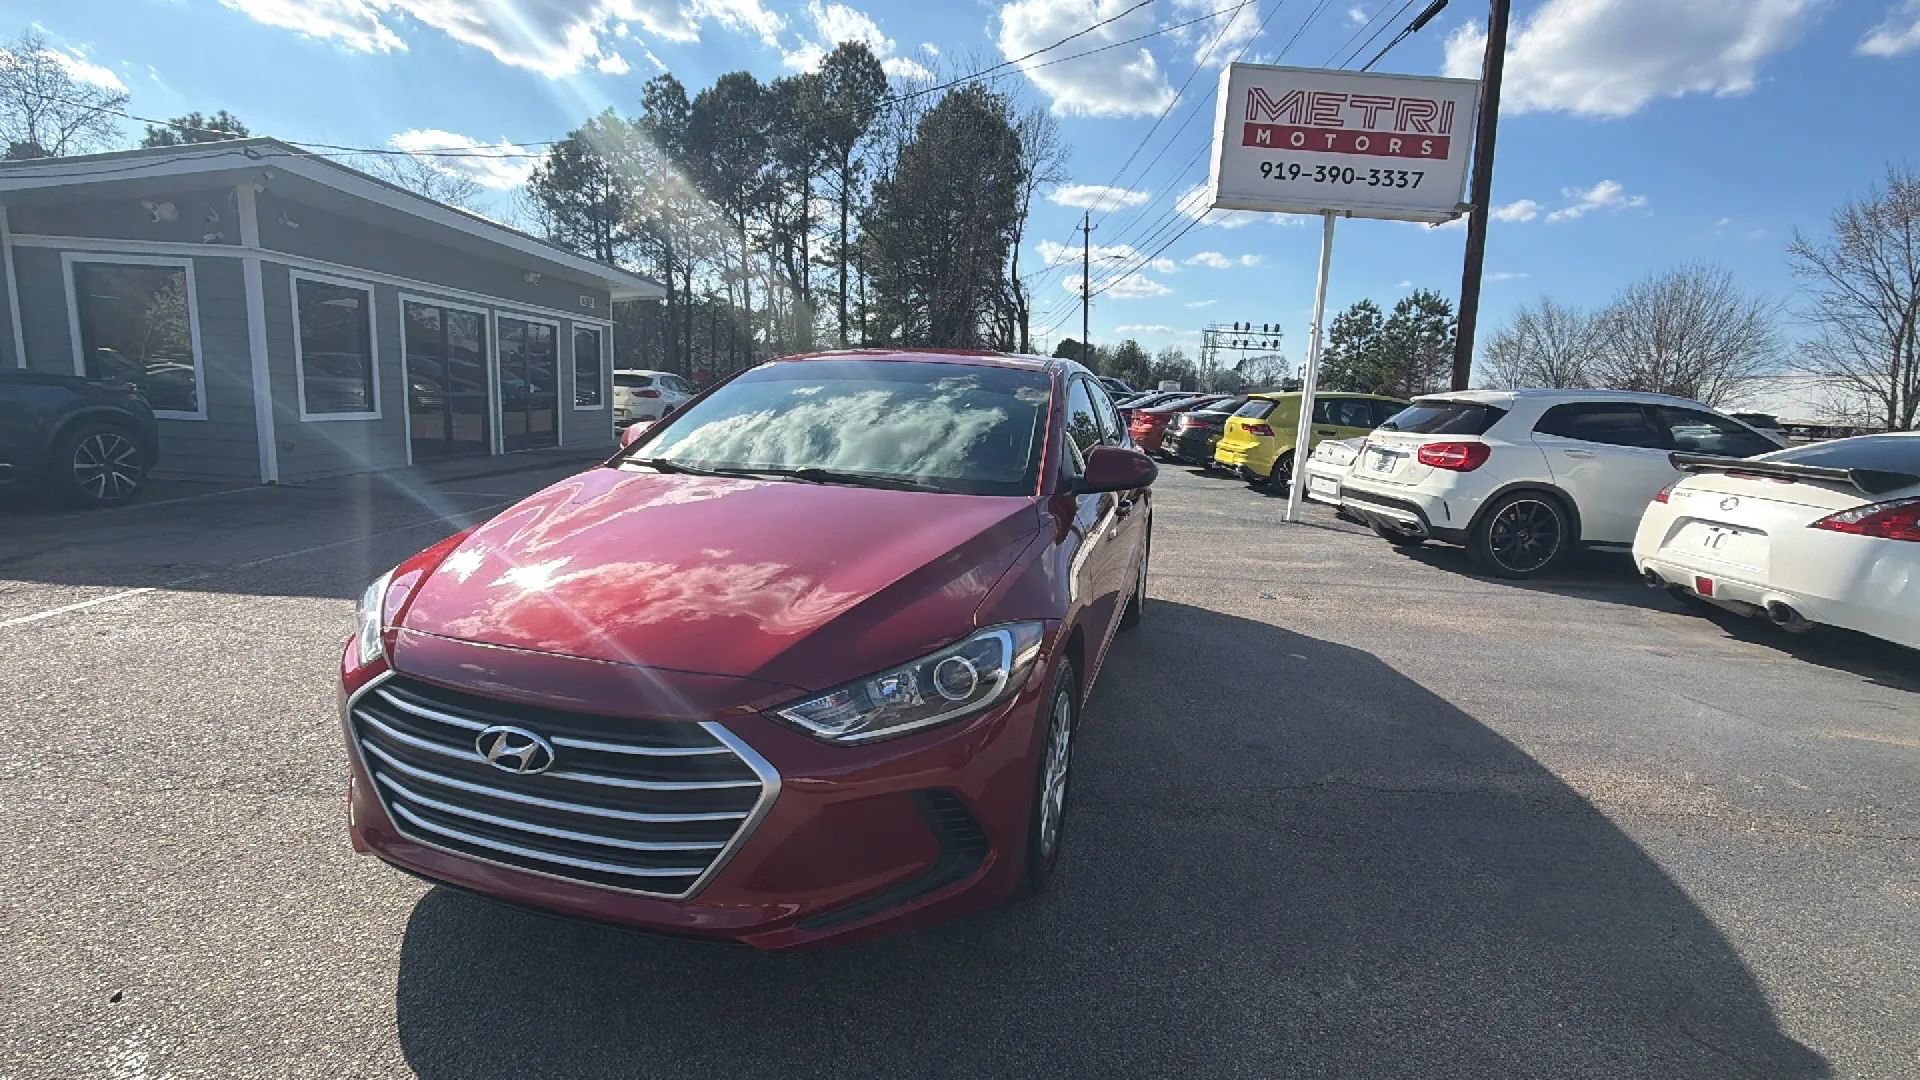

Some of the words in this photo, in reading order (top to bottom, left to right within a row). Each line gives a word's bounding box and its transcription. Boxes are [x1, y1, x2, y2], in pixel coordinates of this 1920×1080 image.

[1247, 87, 1455, 134] METRI
[1257, 128, 1433, 155] MOTORS
[1260, 161, 1425, 189] 919-390-3337
